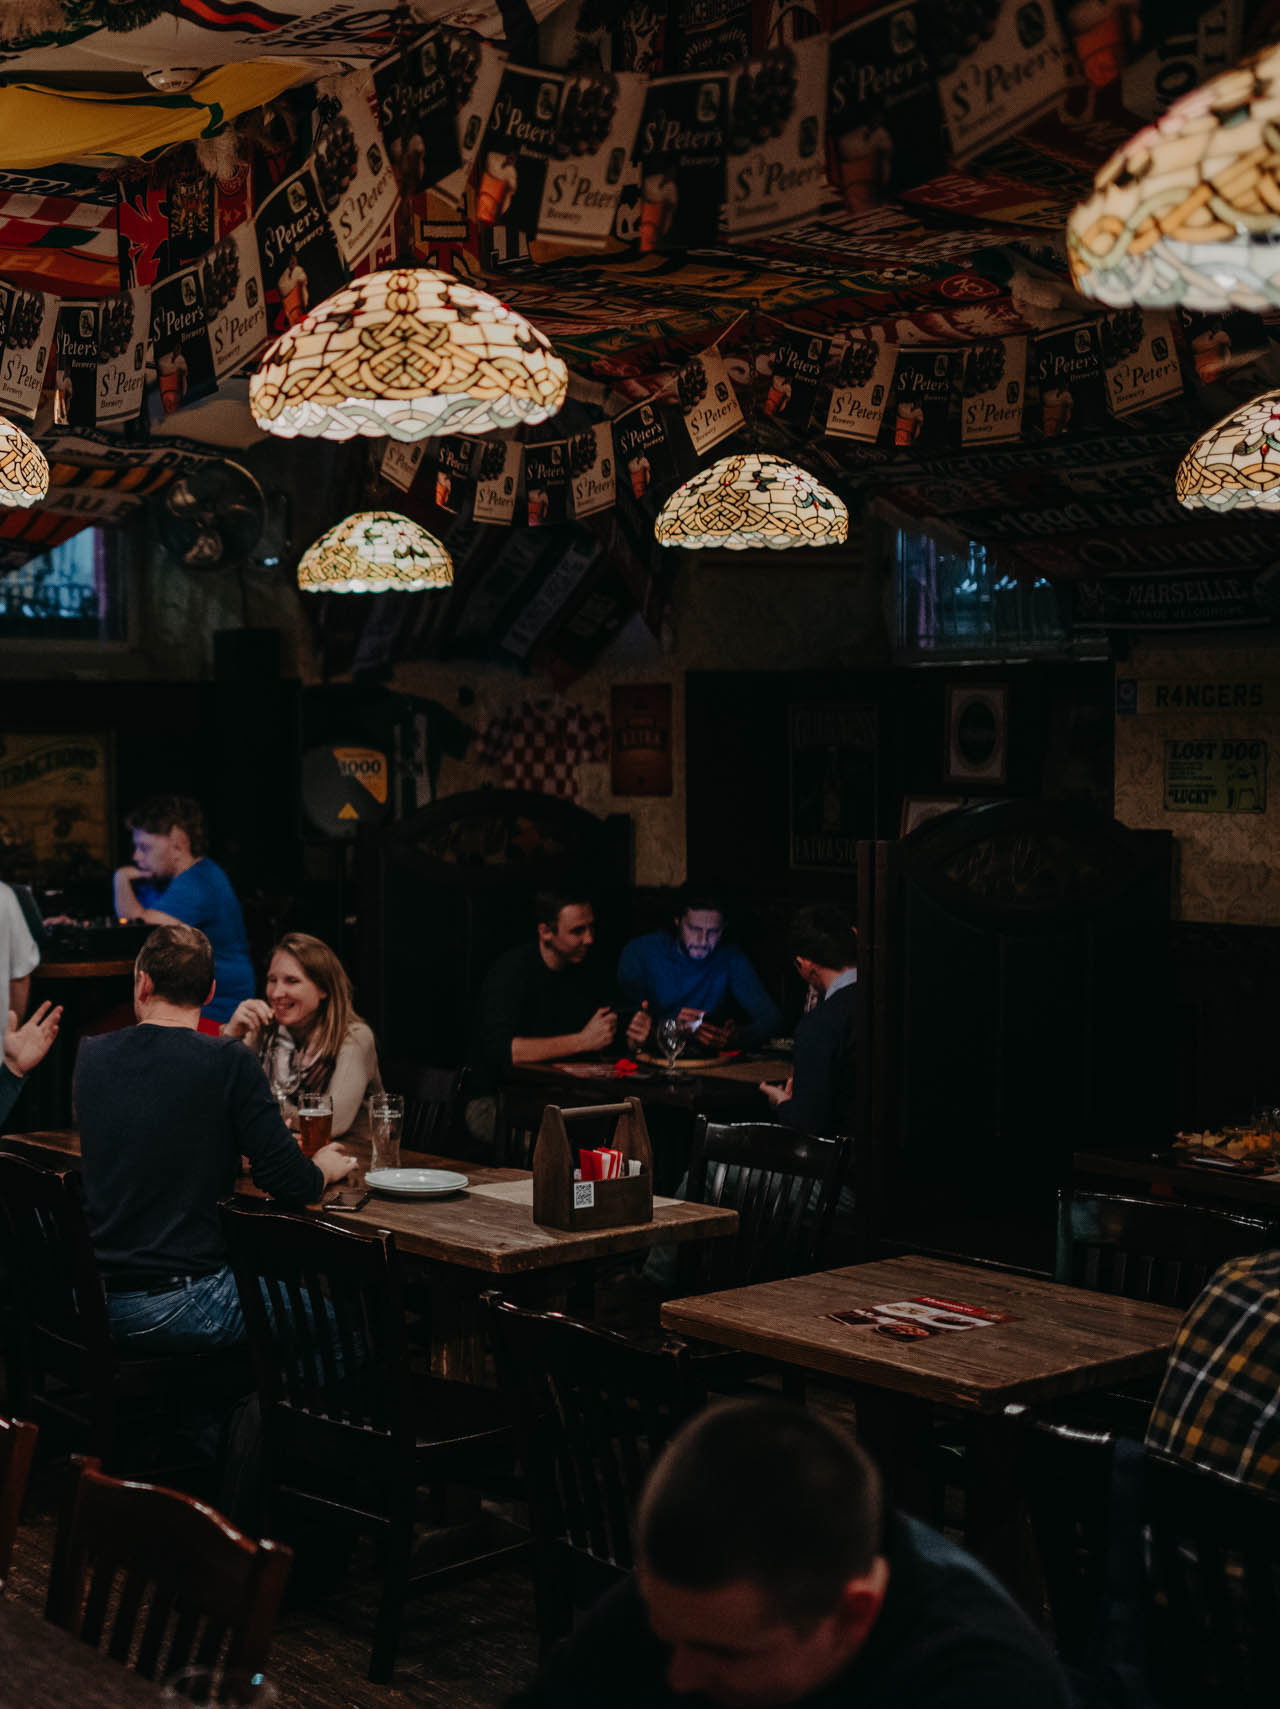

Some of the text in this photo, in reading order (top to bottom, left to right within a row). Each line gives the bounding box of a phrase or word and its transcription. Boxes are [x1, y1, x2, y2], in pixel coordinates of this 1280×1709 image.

[275, 208, 321, 254] Peter's
[166, 306, 205, 337] Peter's
[61, 333, 98, 356] Peter's
[702, 399, 738, 427] Peter's
[628, 424, 664, 449] Peter's
[1170, 742, 1217, 761] LOST
